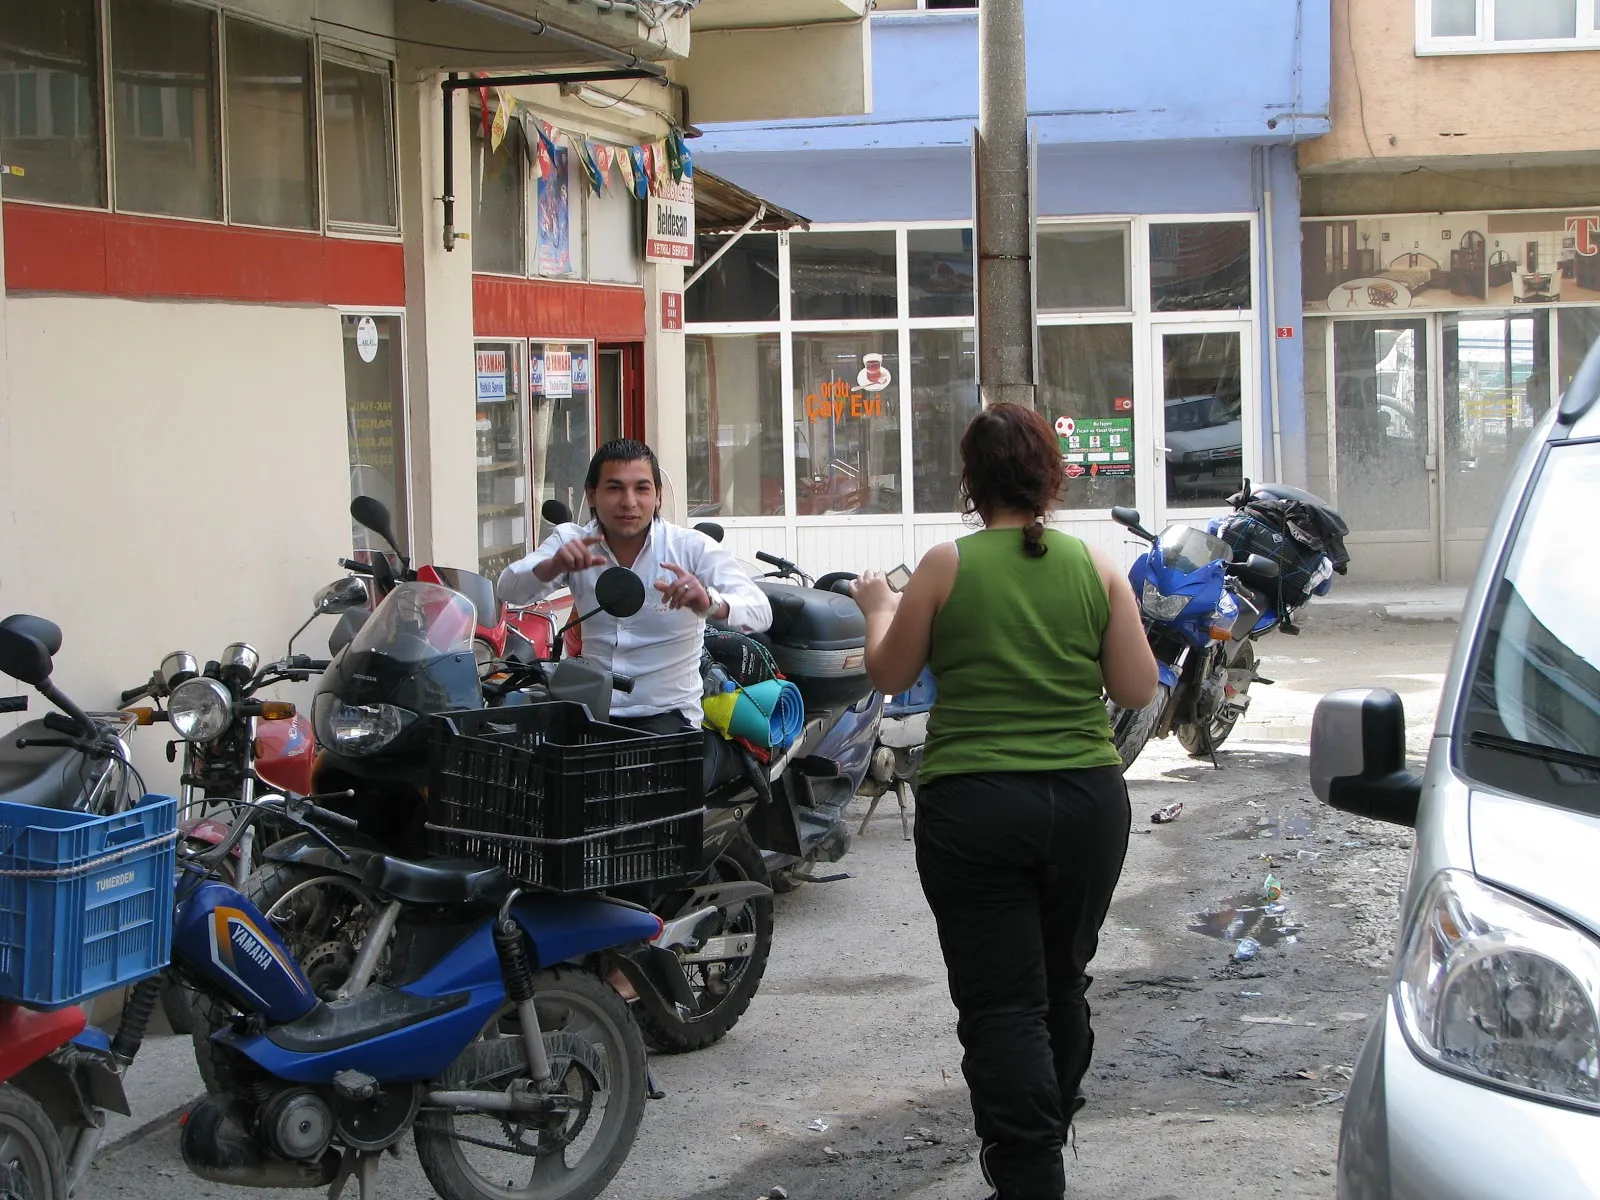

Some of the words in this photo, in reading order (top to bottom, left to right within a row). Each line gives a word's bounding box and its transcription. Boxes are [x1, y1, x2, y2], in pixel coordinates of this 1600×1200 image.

[657, 204, 688, 238] Beldesan
[1282, 328, 1288, 337] 3
[483, 354, 504, 373] YAMAHA
[551, 354, 571, 371] YAMAHA
[573, 371, 587, 382] LIFAN
[492, 381, 504, 393] Servis
[821, 377, 848, 398] ordu
[806, 394, 845, 425] Çay
[851, 394, 881, 416] Evi
[352, 673, 377, 682] HONDA
[231, 924, 273, 970] YAMAHA
